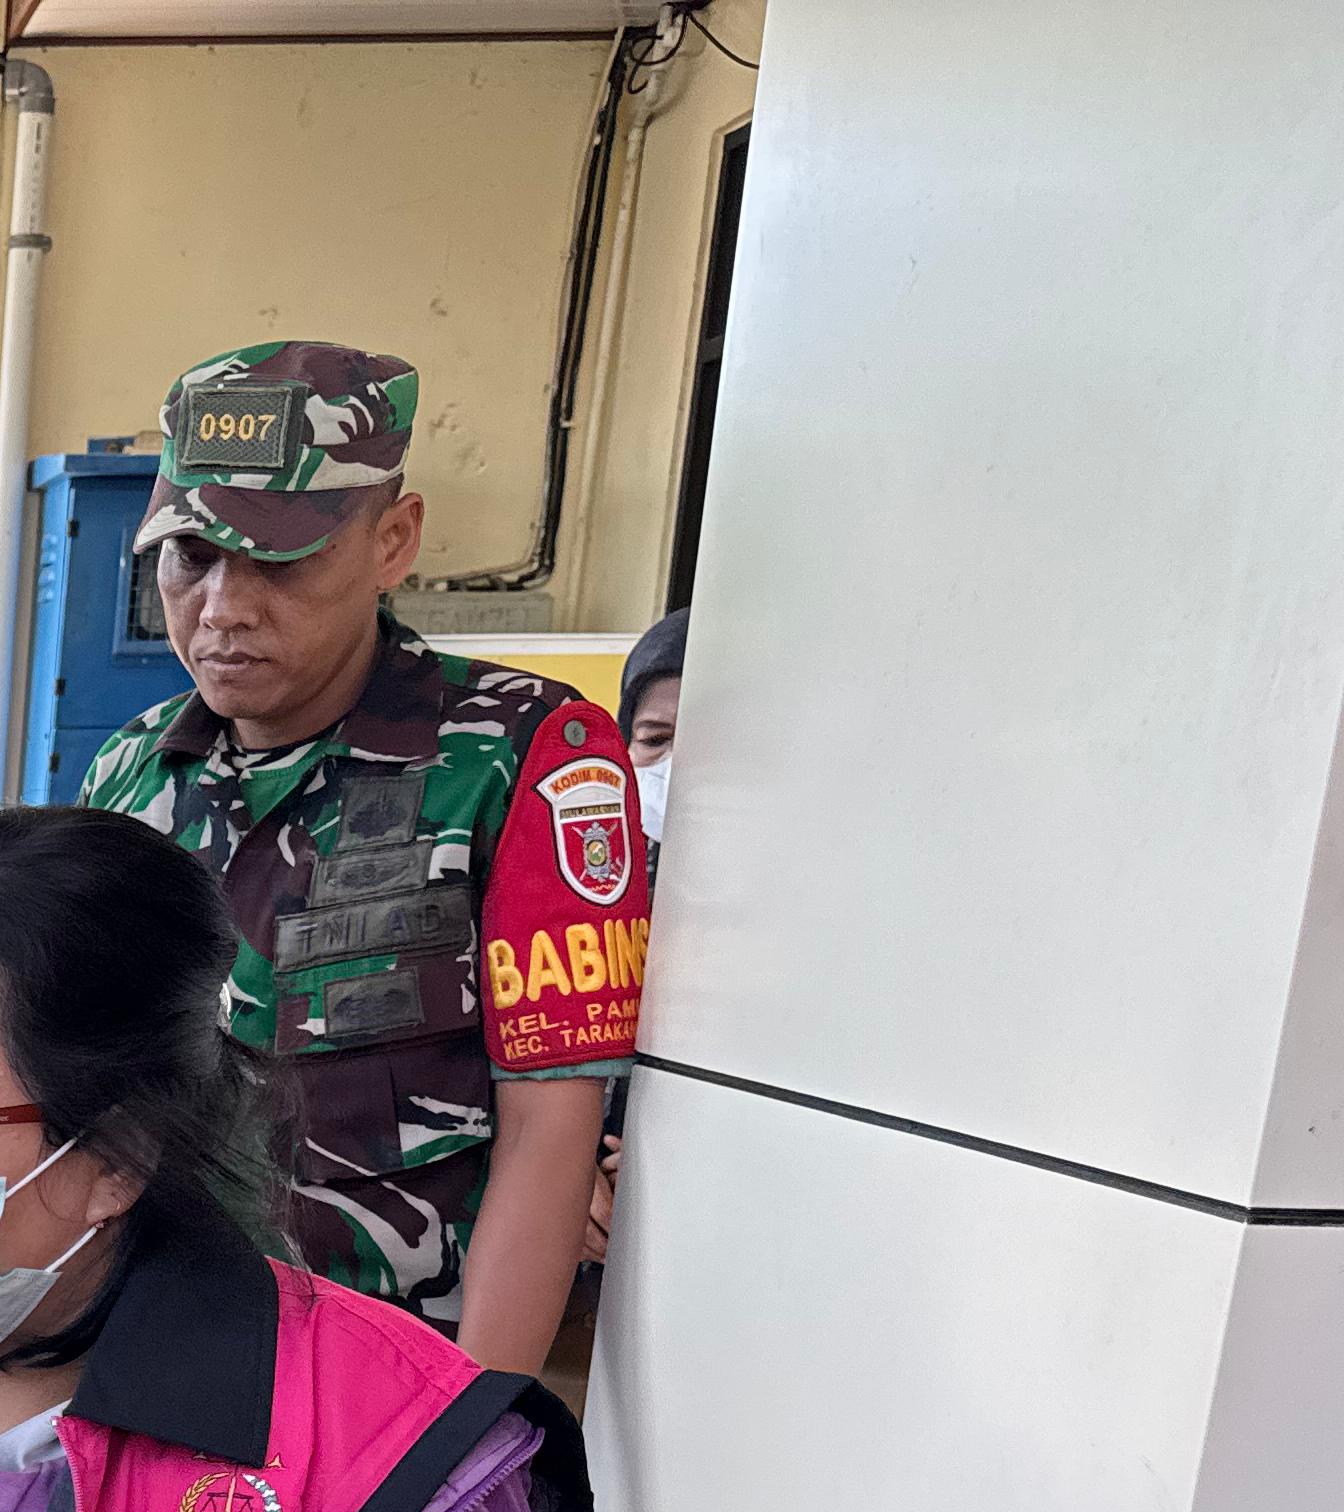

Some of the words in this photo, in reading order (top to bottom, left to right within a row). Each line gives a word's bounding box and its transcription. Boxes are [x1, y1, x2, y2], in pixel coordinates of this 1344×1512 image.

[200, 413, 277, 441] 0907
[499, 1012, 569, 1040] KEL.
[586, 998, 640, 1022] PAM
